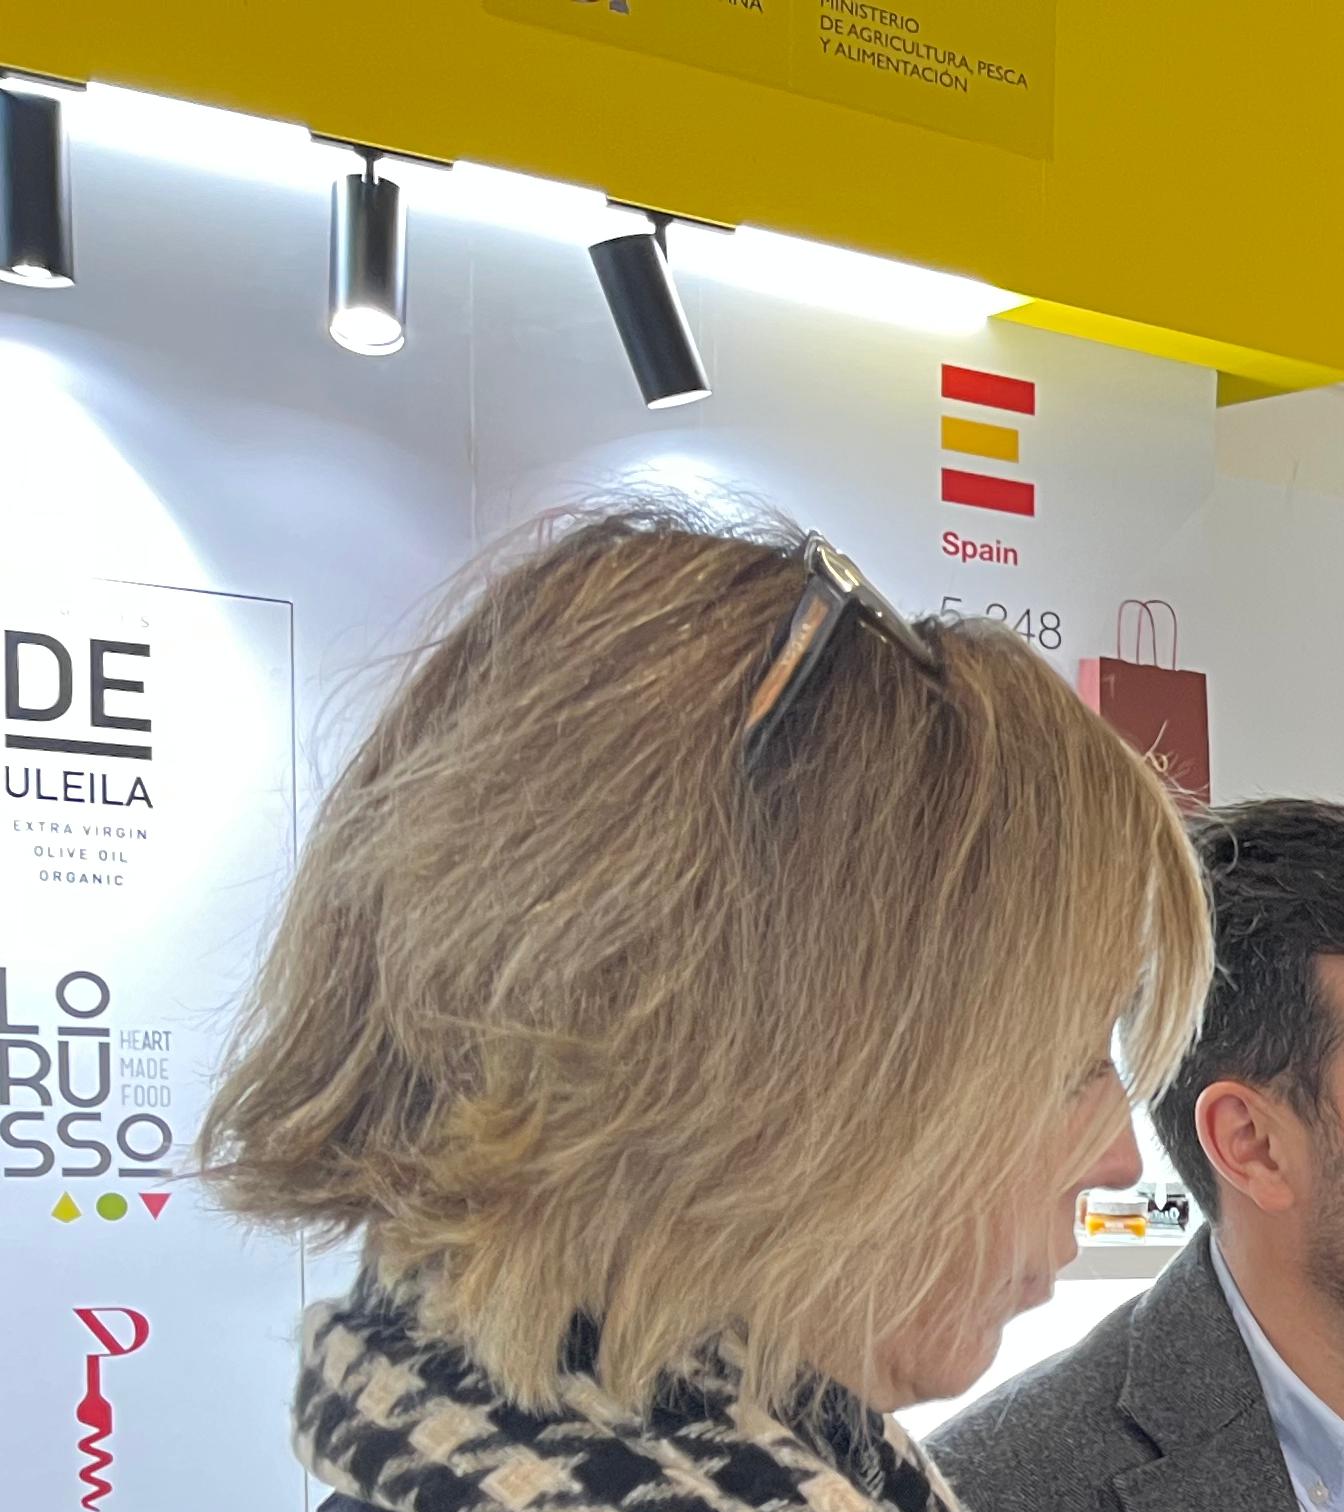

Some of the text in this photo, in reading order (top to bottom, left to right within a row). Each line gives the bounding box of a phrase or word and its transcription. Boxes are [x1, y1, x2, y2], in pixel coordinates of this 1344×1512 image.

[820, 0, 920, 34] MINISTERIO
[820, 15, 1029, 89] DE AGRICULTURA, PESCA
[820, 37, 969, 93] Y ALIMENTACIÓN
[942, 531, 1019, 567] Spain
[4, 629, 152, 733] DE
[5, 765, 154, 809] ULEILA
[13, 819, 148, 840] EXTRA VIRGIN
[33, 845, 128, 863] OLIVE OIL
[39, 869, 124, 886] ORGANIC
[119, 1030, 172, 1052] HEART
[119, 1057, 169, 1080] MADE
[121, 1084, 171, 1108] FOOD
